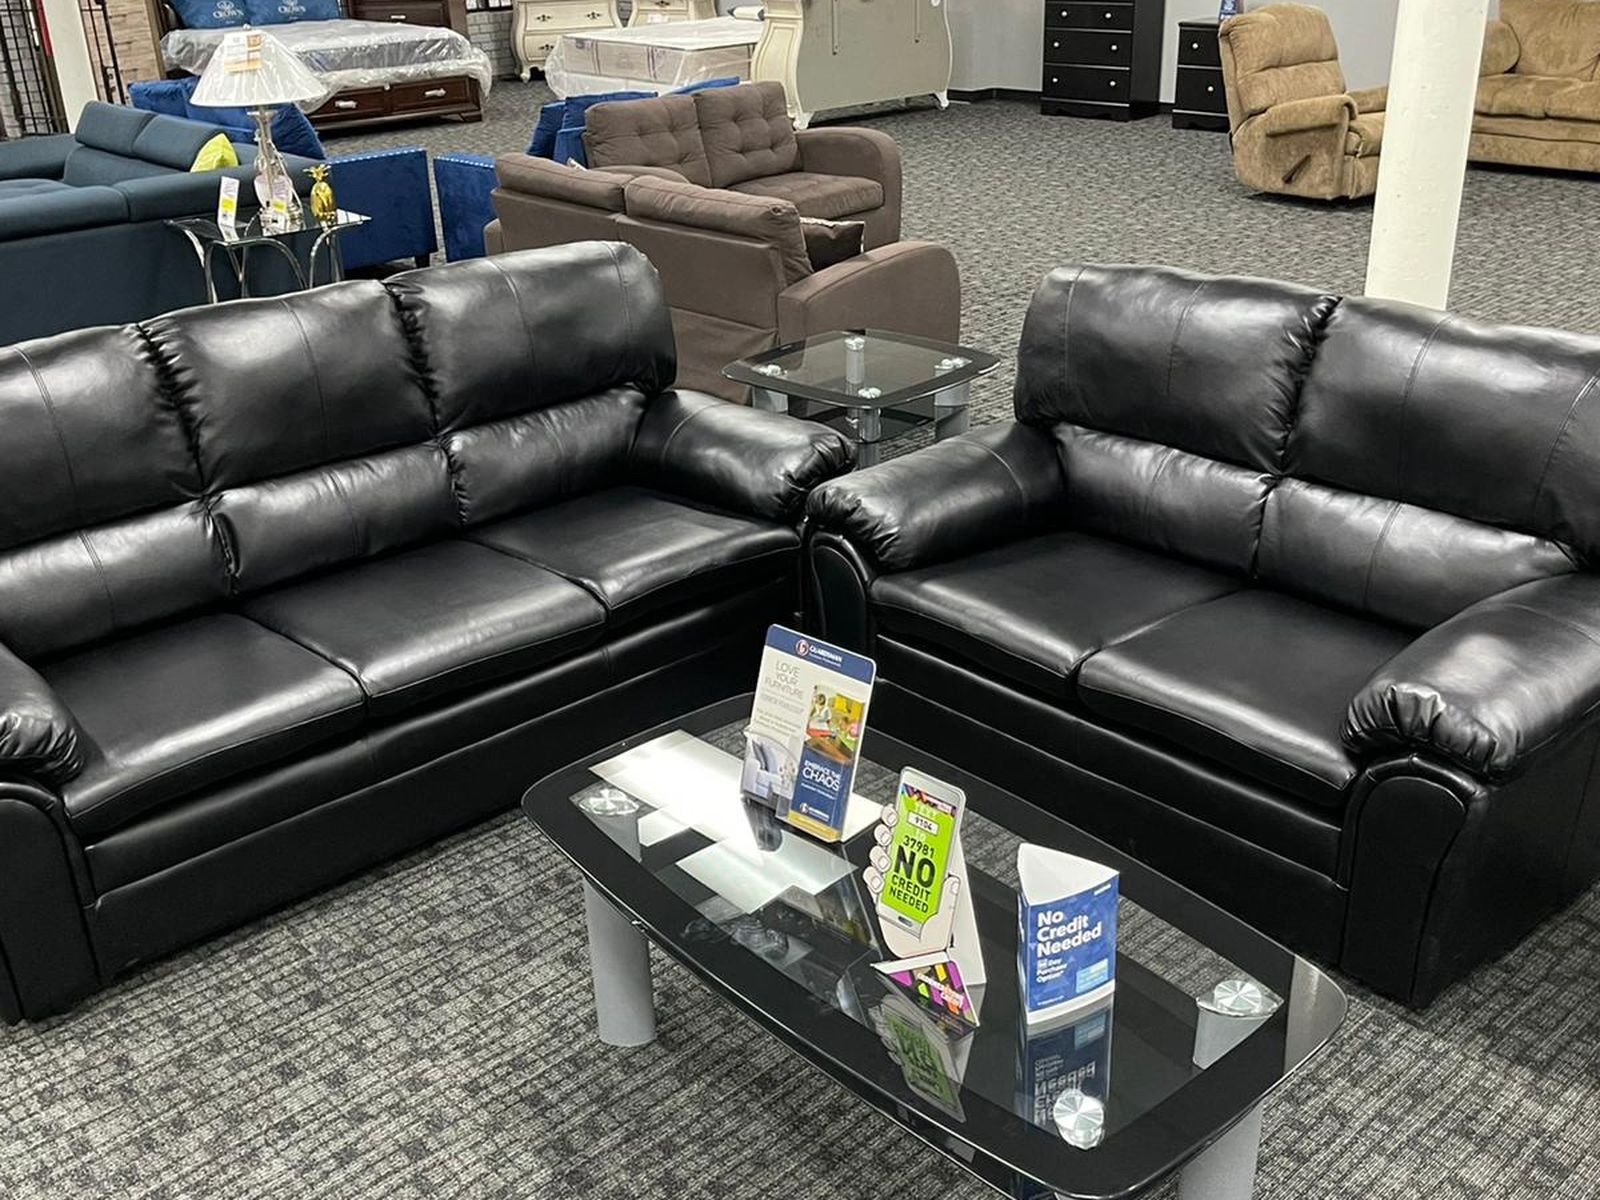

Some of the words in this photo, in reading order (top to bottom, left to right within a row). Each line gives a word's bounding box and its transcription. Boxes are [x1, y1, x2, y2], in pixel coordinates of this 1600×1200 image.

[802, 767, 841, 792] CHAOS
[903, 835, 935, 858] 37981
[894, 845, 936, 888] NO
[889, 886, 929, 913] NEEDED
[891, 874, 932, 901] CREDIT
[1036, 915, 1089, 942] Credit
[1037, 910, 1064, 927] No
[1036, 921, 1102, 957] Needed
